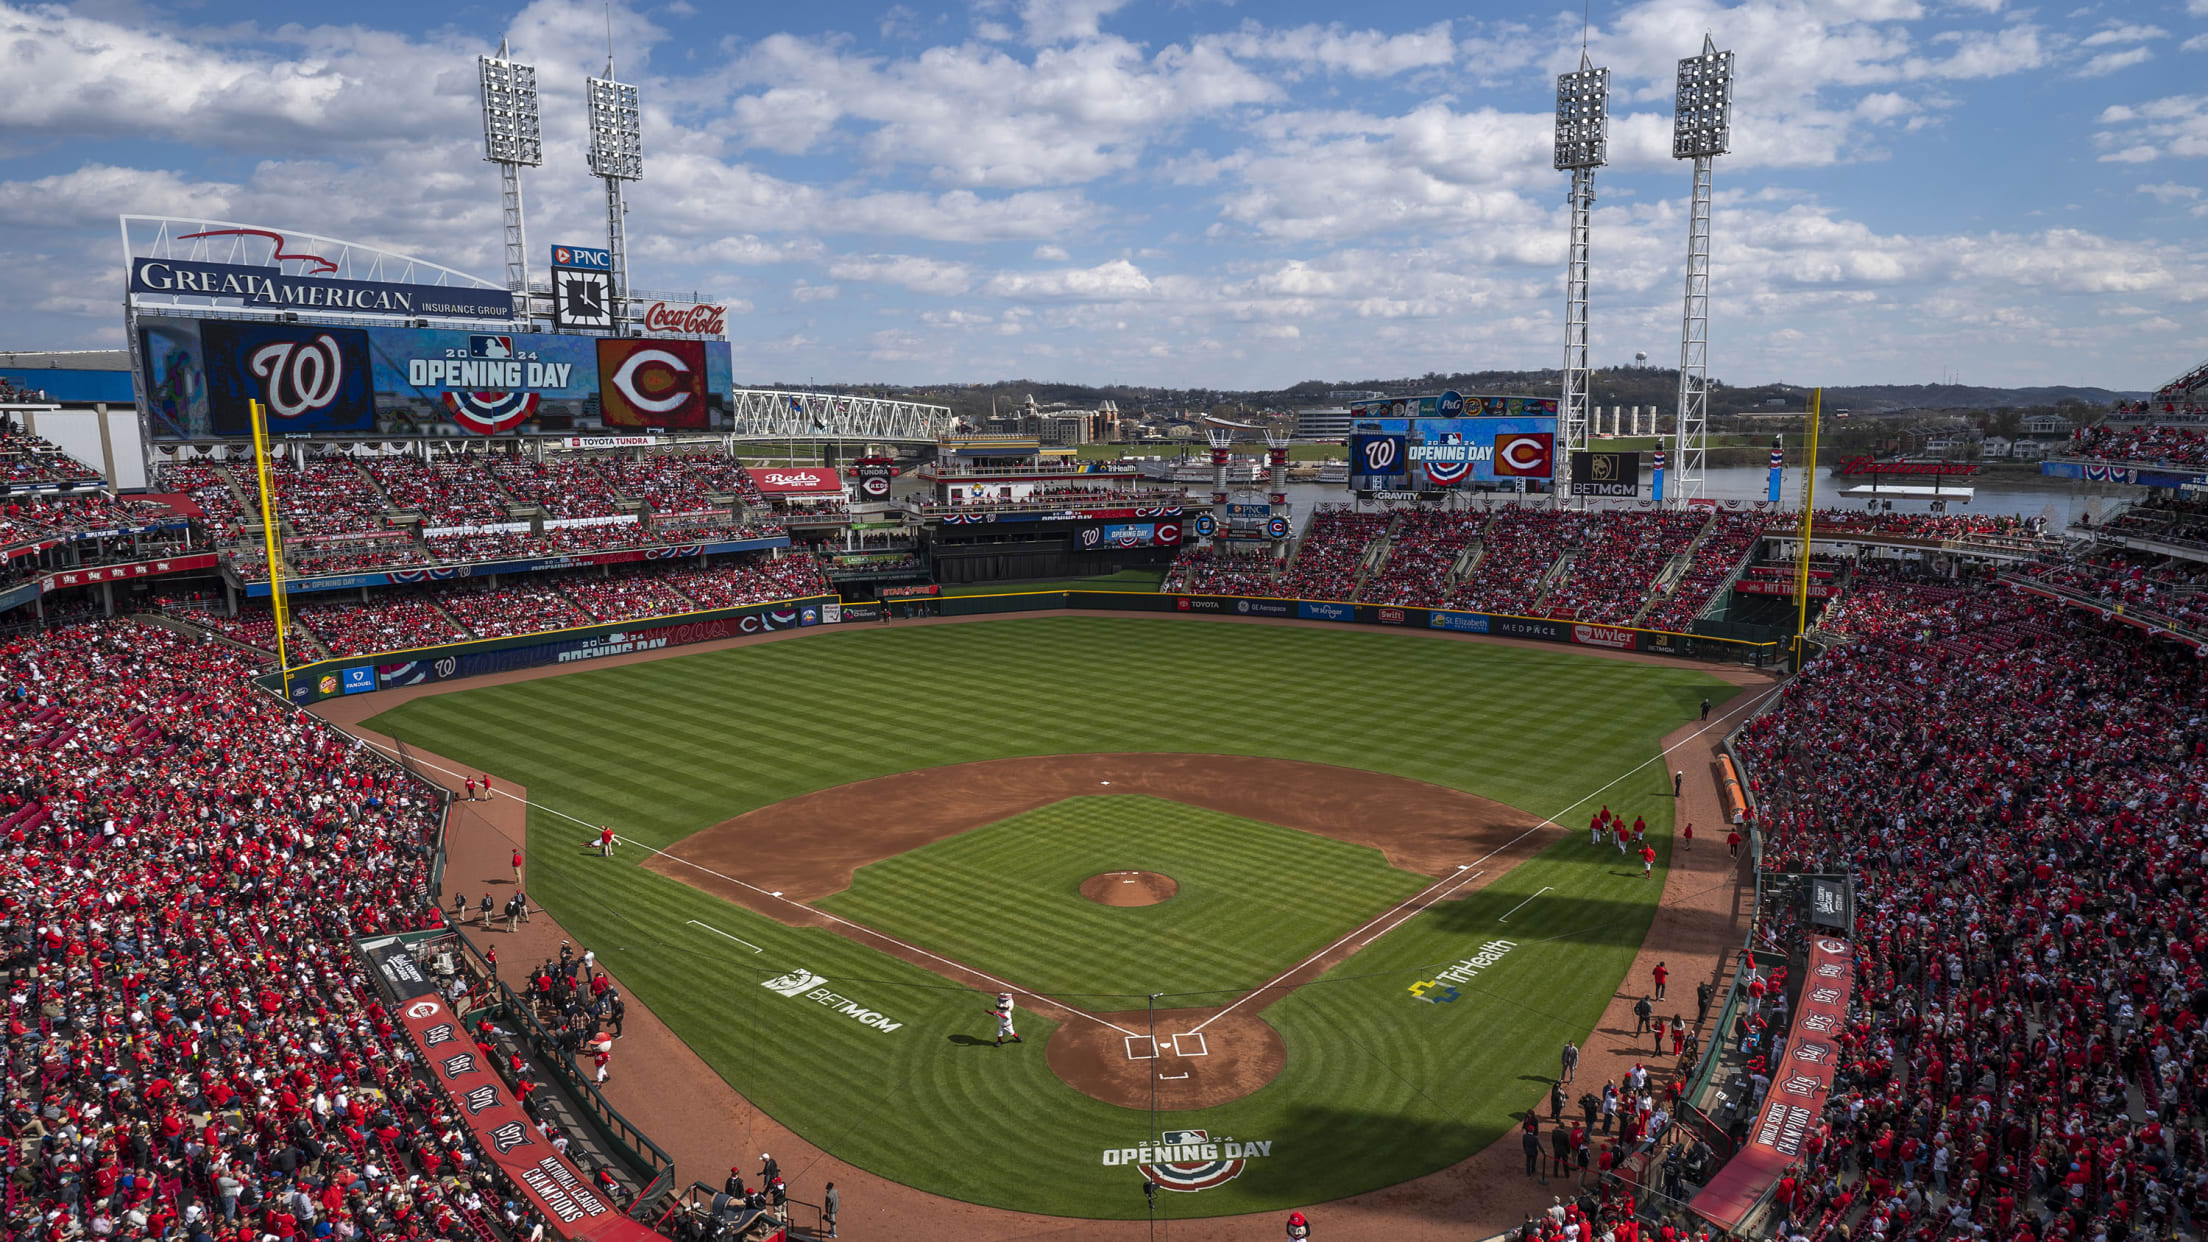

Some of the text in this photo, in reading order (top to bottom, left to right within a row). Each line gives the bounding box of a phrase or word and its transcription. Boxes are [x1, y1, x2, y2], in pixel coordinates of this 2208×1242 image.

[572, 249, 609, 267] PNC
[421, 302, 475, 314] INSURANCE
[477, 306, 508, 316] GROUP
[645, 301, 727, 335] Coca-Cola
[445, 349, 467, 358] 20
[409, 359, 572, 388] OPENING DAY
[583, 437, 649, 446] TOYOTA TUNDRA
[1408, 446, 1494, 460] OPENING DAY
[1107, 464, 1136, 473] TriHealth
[1840, 455, 1979, 476] Budweiser
[764, 471, 821, 486] Reds
[1377, 492, 1419, 500] GRAVITY
[1573, 482, 1636, 497] BETMGM
[1242, 505, 1263, 514] PNC
[1111, 530, 1148, 538] OPENING DAY
[312, 580, 341, 589] OPENING
[343, 578, 356, 586] DAY
[1764, 583, 1779, 593] HIT
[1782, 584, 1799, 594] THE
[1191, 601, 1220, 609] TOYOTA
[1259, 604, 1287, 612] Aerospace
[1319, 605, 1343, 619] Kroger
[1381, 610, 1401, 619] Swift
[1455, 617, 1488, 627] Elizabeth
[1502, 623, 1556, 636] MEDPACE
[1592, 627, 1633, 642] Wyler
[346, 680, 373, 689] FANDUEL
[1435, 939, 1518, 984] TriHealth
[805, 988, 903, 1034] BETMGM
[1805, 1014, 1835, 1032] 1975
[1797, 1044, 1826, 1063] 1940
[446, 1054, 470, 1075] 1961
[1787, 1075, 1817, 1095] 1919
[469, 1086, 494, 1110] 1970
[1757, 1102, 1788, 1146] WORLD SERIES
[1776, 1105, 1812, 1156] CHAMPIONS
[494, 1123, 522, 1148] 1972
[1102, 1140, 1272, 1166] OPENING DAY
[539, 1156, 607, 1217] NATIONAL LEAGUE
[521, 1167, 585, 1223] CHAMPIONS
